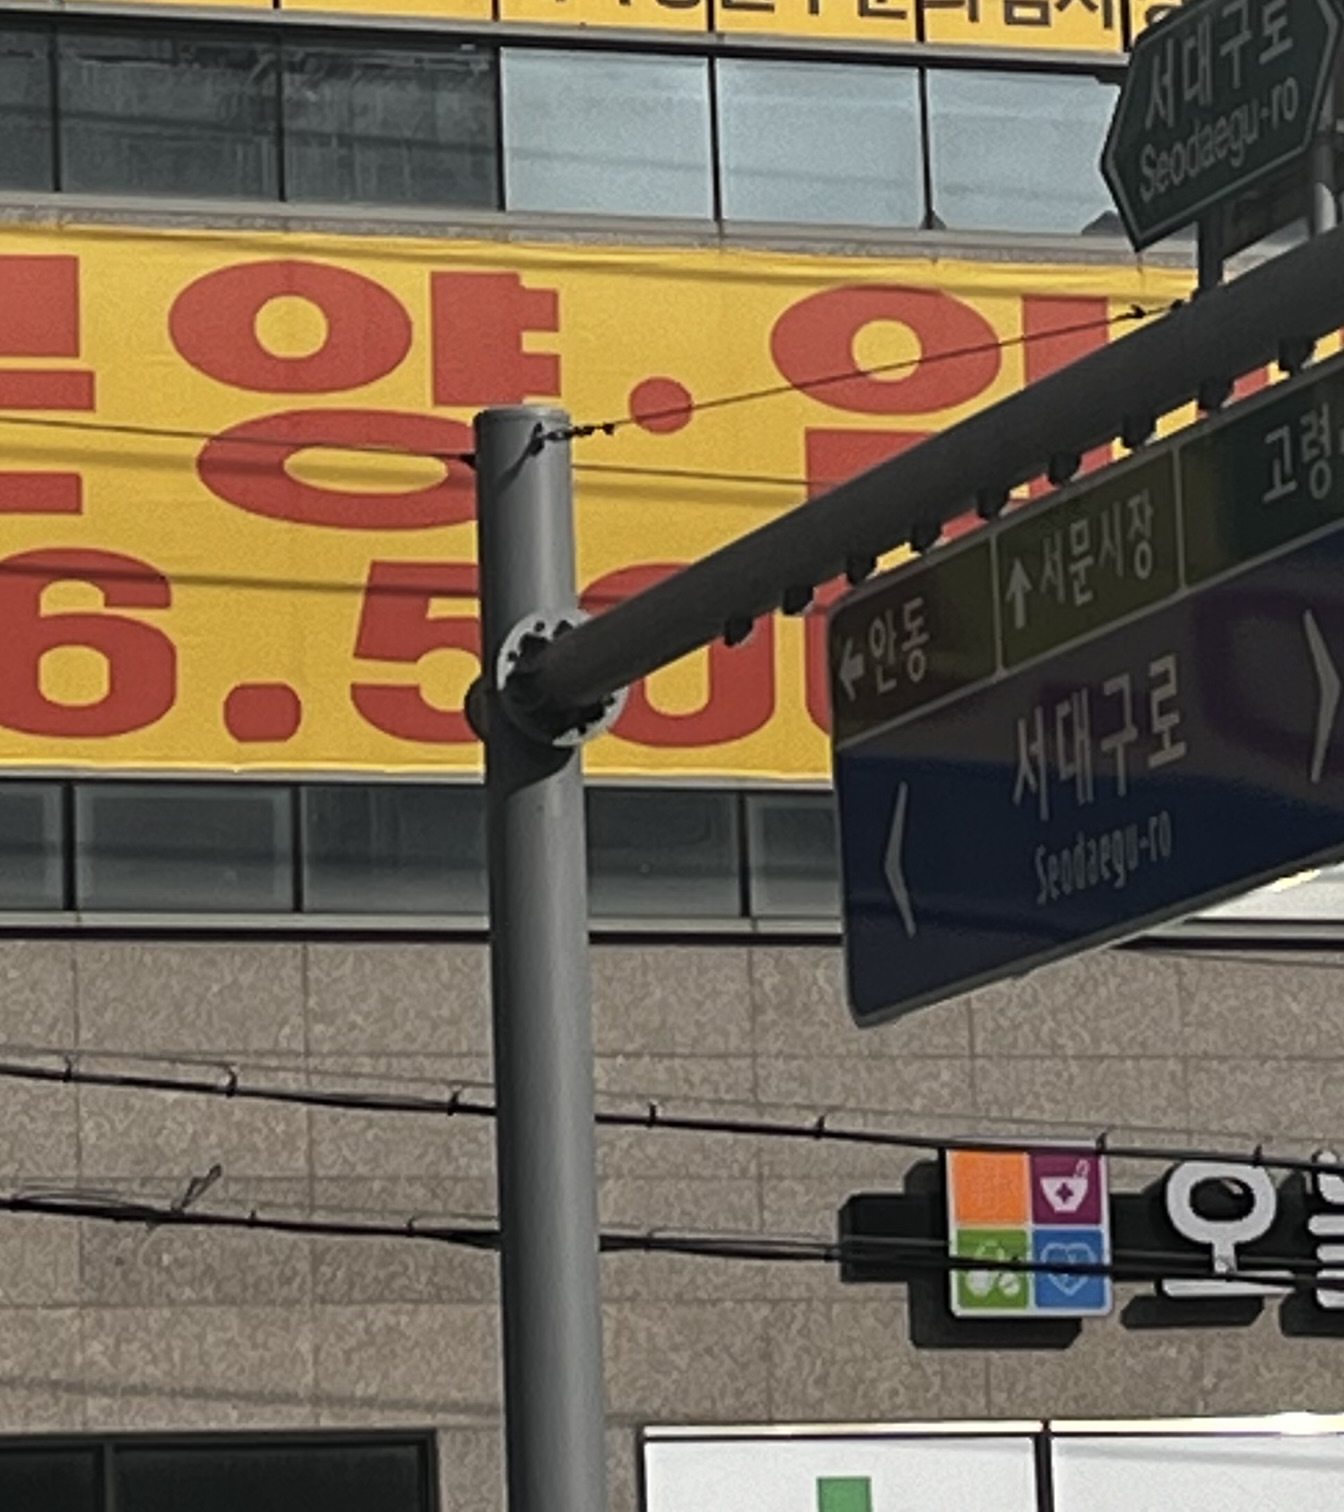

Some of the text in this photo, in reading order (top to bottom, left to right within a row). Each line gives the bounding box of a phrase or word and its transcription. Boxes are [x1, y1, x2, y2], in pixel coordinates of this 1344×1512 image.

[1139, 76, 1299, 203] Seodaegu-ro
[1263, 402, 1335, 504] 고령
[1038, 489, 1154, 606] 서문시장
[867, 596, 931, 695] 안동
[1012, 654, 1188, 822] 서대구로
